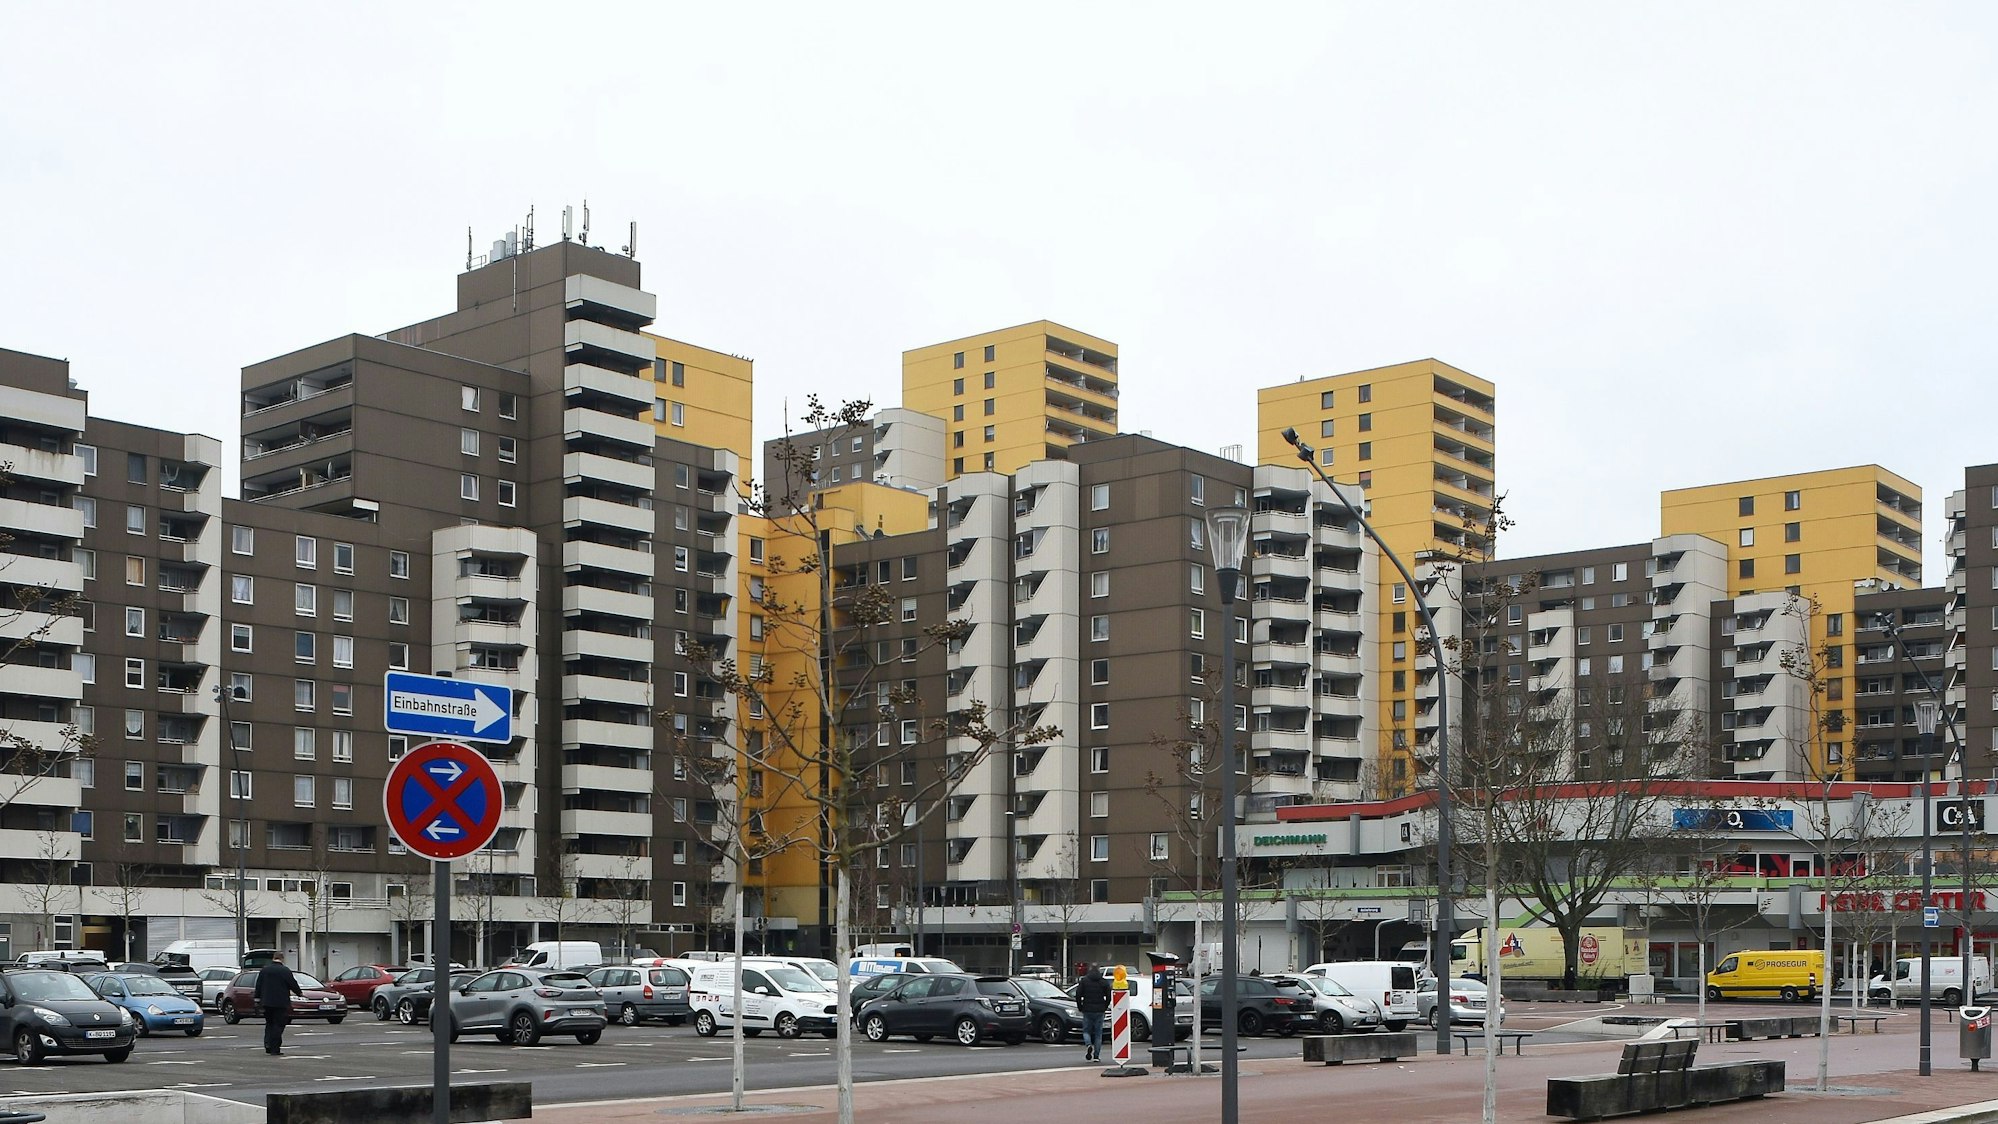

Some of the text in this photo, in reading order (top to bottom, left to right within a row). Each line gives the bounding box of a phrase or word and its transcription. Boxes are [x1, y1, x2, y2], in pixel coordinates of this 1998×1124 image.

[394, 695, 477, 717] Einbahnstraße
[1727, 811, 1744, 829] O2
[1942, 806, 1978, 825] C&A
[1253, 833, 1328, 847] DEICHMANN
[1766, 960, 1807, 968] PROSEGUR
[1154, 973, 1161, 983] P
